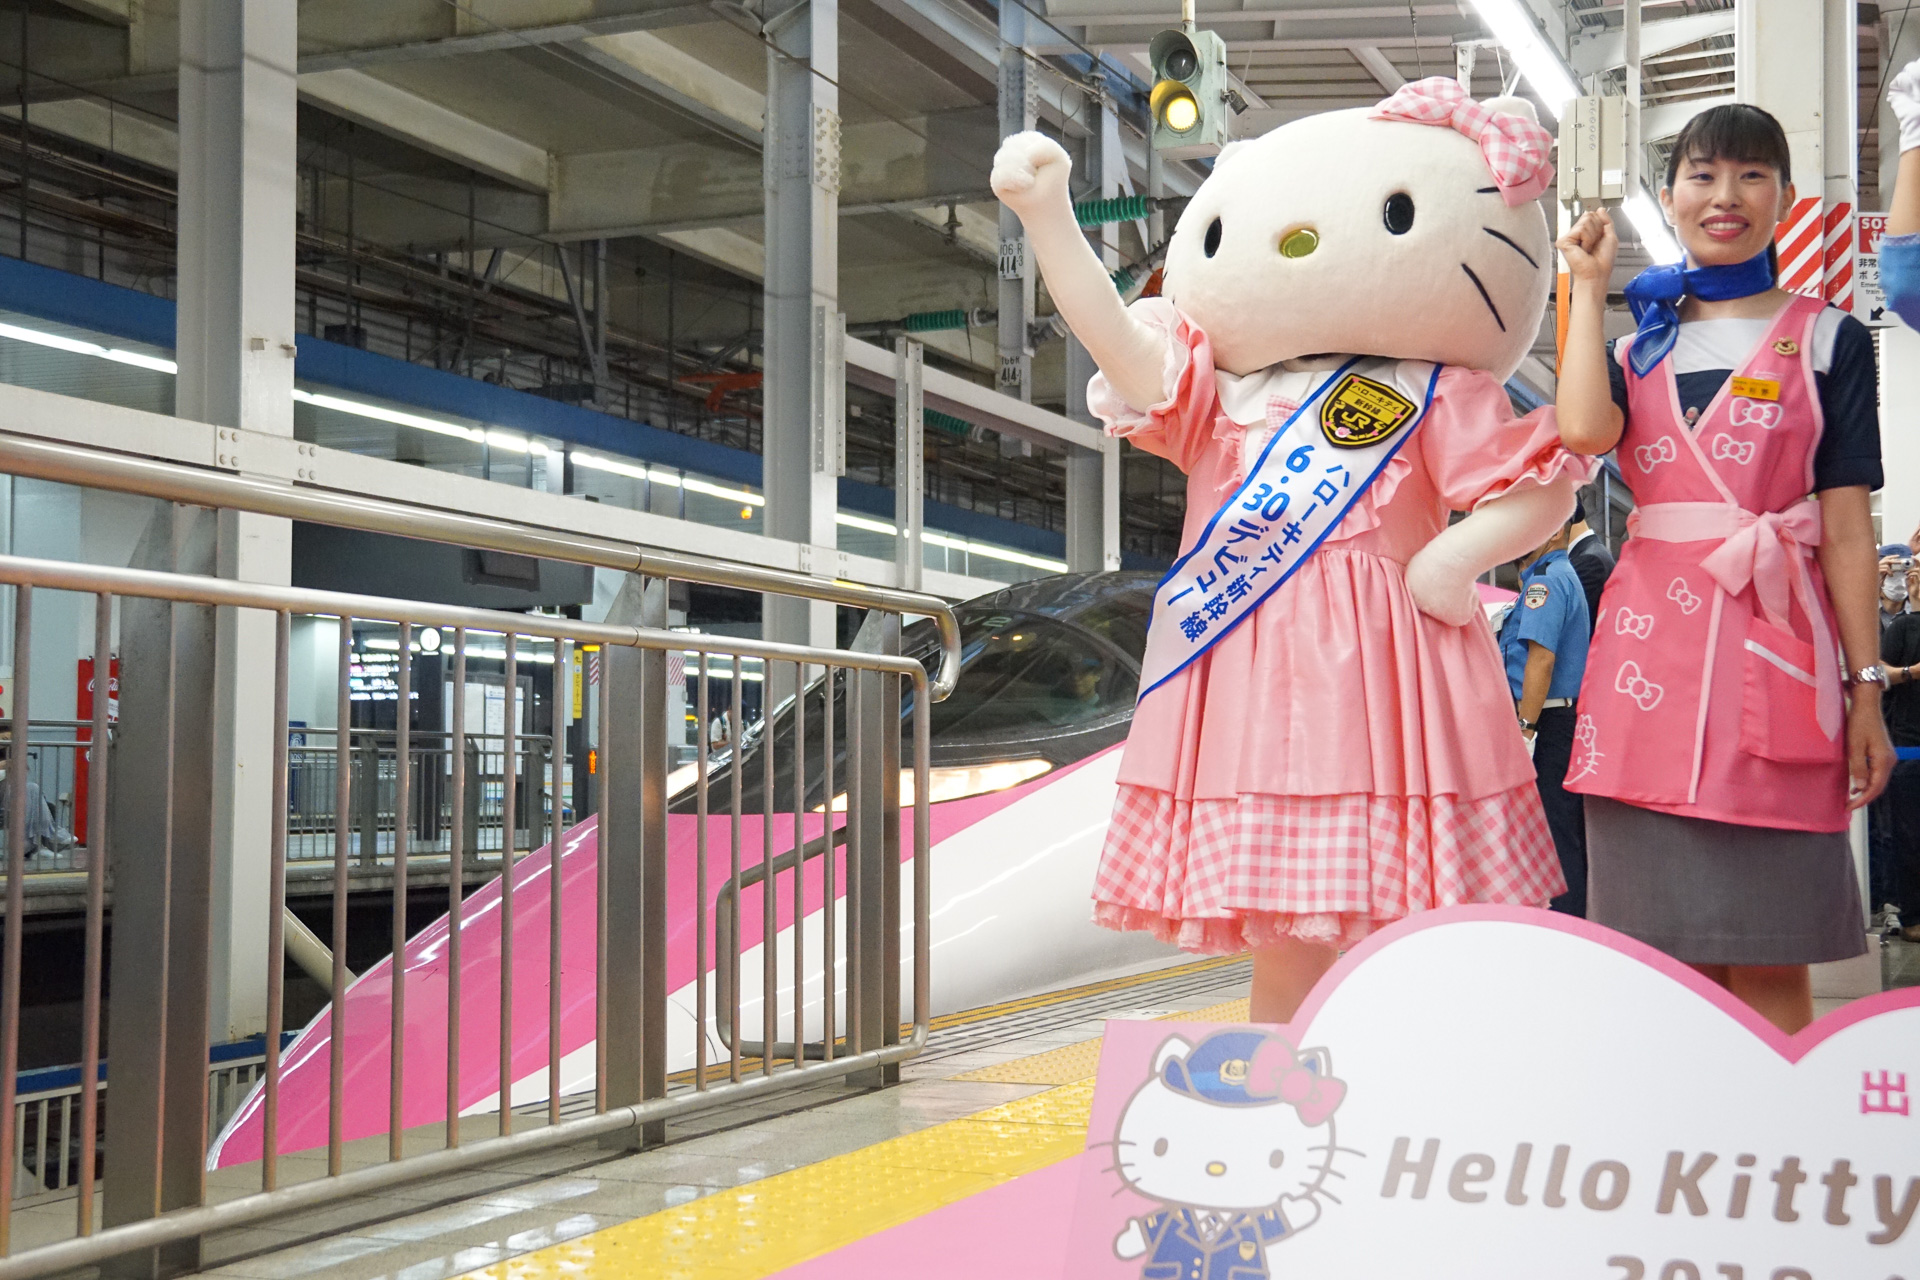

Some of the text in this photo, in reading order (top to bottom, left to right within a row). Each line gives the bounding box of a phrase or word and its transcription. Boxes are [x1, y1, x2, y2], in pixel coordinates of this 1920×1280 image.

[1352, 385, 1399, 411] ハローキティ
[1179, 464, 1350, 643] ハローキティ新幹線
[1859, 1069, 1910, 1117] 出
[1379, 1136, 1920, 1245] Hello Kitty
